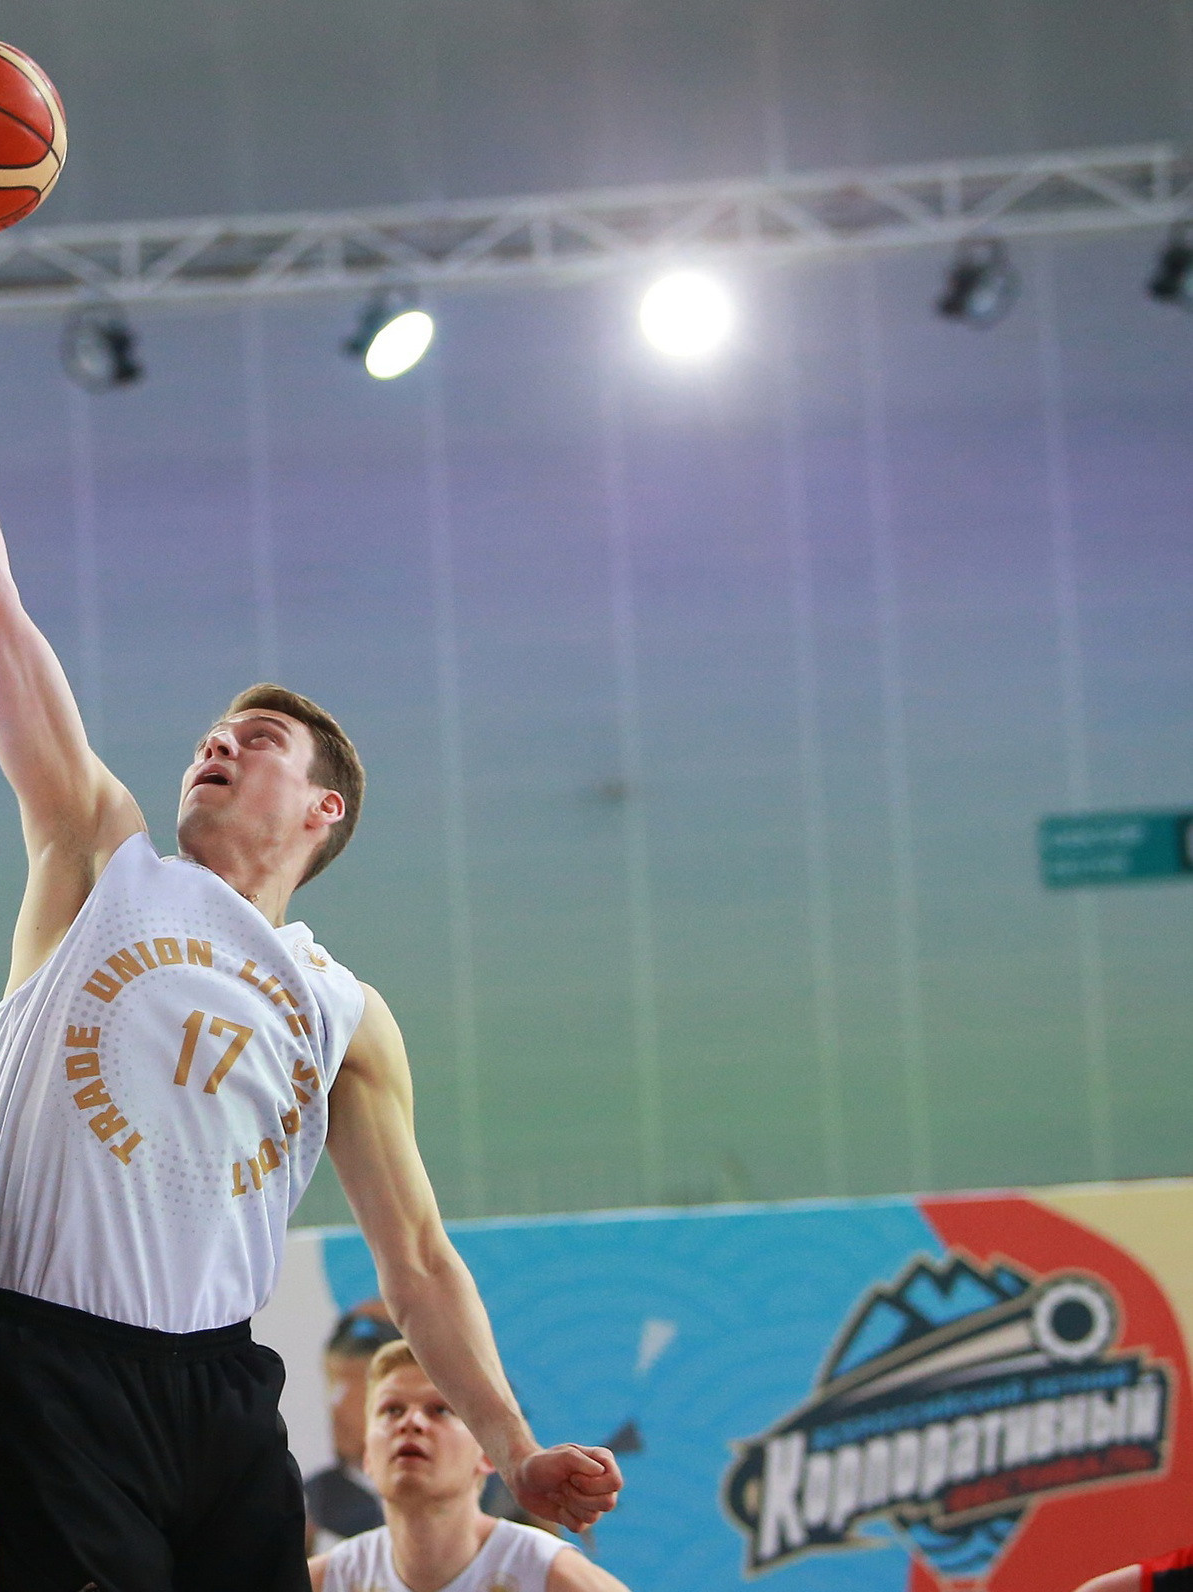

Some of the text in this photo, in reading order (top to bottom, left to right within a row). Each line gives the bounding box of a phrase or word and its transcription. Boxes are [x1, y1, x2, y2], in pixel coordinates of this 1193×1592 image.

[82, 937, 213, 1003] UNION
[173, 1010, 253, 1094] 17
[65, 1025, 143, 1166] TRADE
